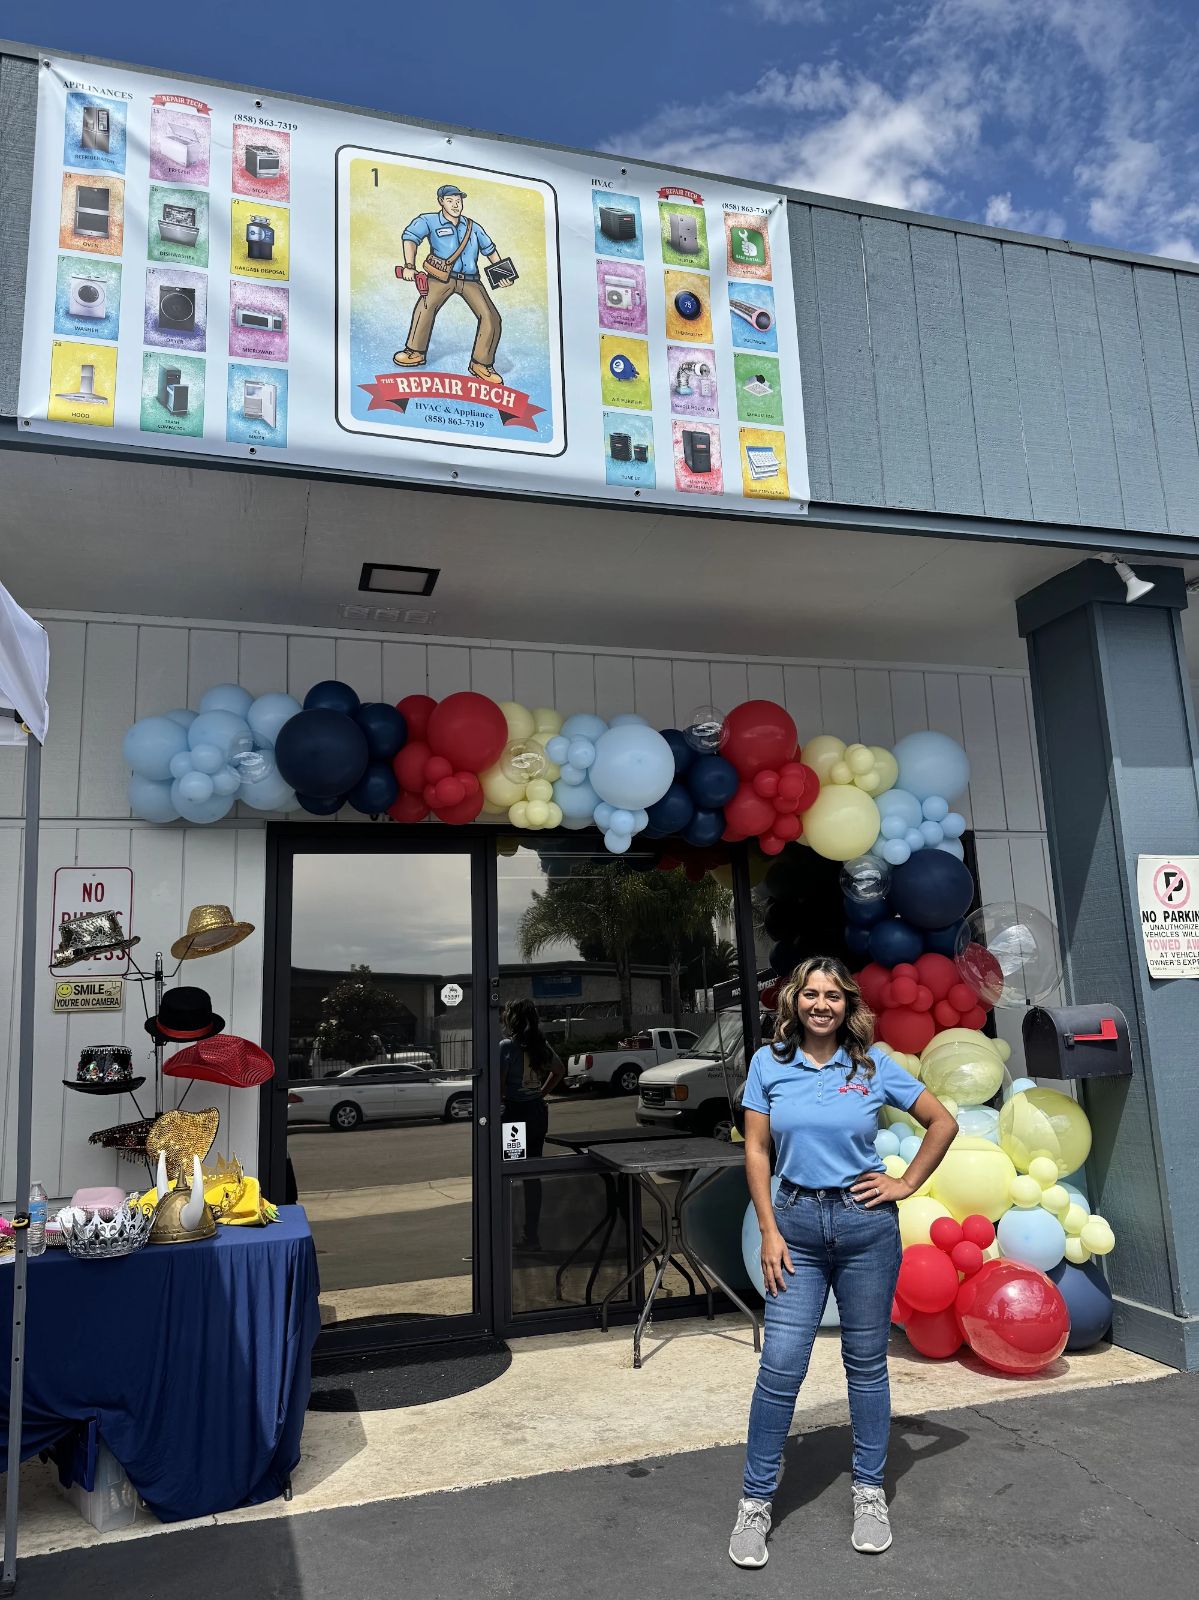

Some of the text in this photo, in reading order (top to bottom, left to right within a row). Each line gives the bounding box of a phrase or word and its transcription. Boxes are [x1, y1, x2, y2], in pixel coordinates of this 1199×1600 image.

[63, 81, 133, 100] APPLINANCES
[162, 96, 204, 108] REPAIR TECH
[234, 114, 298, 131] (858) 863-7319
[371, 168, 379, 187] 1
[592, 178, 614, 188] HVAC
[684, 190, 698, 200] TECH
[722, 202, 740, 211] (858)
[396, 376, 463, 396] REPAIR
[468, 382, 516, 408] TECH
[415, 402, 442, 412] HVAC
[454, 408, 494, 419] Appliance
[424, 415, 484, 428] (858) 863-7319
[82, 882, 104, 902] NO
[1142, 910, 1156, 922] NO
[1147, 939, 1181, 950] TOWED
[74, 984, 104, 995] SMILE
[56, 998, 120, 1007] YOU'RE ON CAMERA
